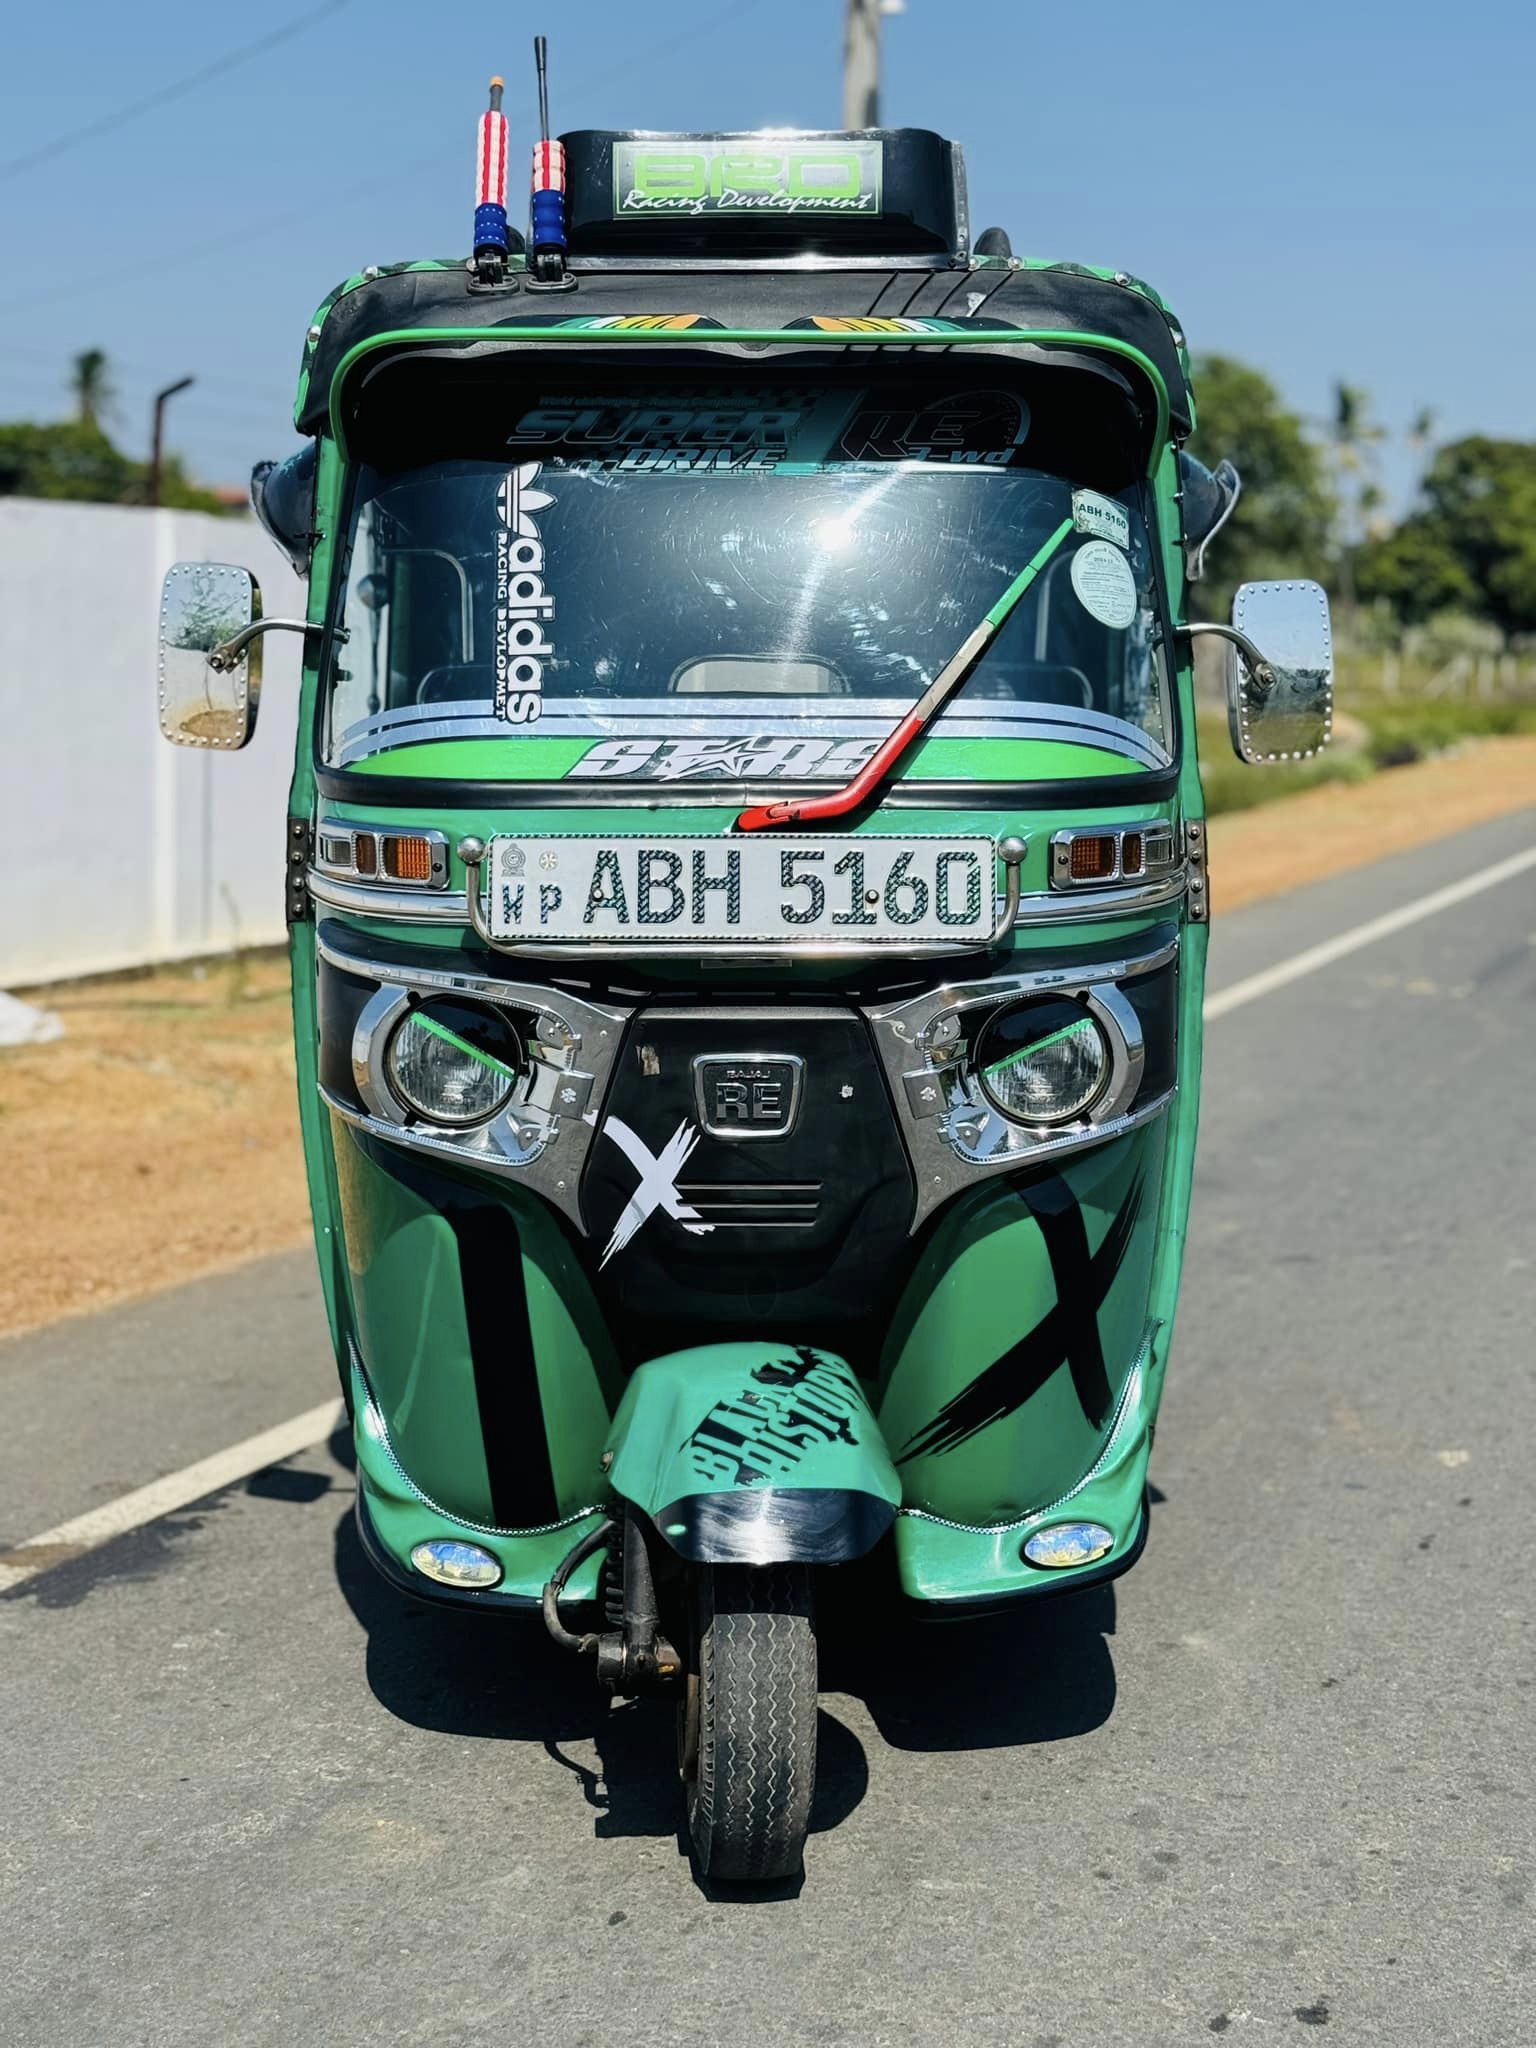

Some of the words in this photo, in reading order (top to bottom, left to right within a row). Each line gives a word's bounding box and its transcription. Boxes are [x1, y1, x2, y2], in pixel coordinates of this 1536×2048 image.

[622, 189, 708, 214] Racing
[717, 187, 873, 214] Development
[506, 408, 802, 446] SUPER
[617, 447, 787, 471] DRIVE
[1078, 503, 1102, 518] ABH
[1104, 511, 1127, 530] 5160
[498, 532, 508, 600] RACING
[507, 536, 554, 723] adidas
[583, 849, 741, 924] ABH
[780, 850, 981, 925] 5160
[726, 1070, 771, 1079] BAJAJ
[716, 1083, 782, 1119] RE
